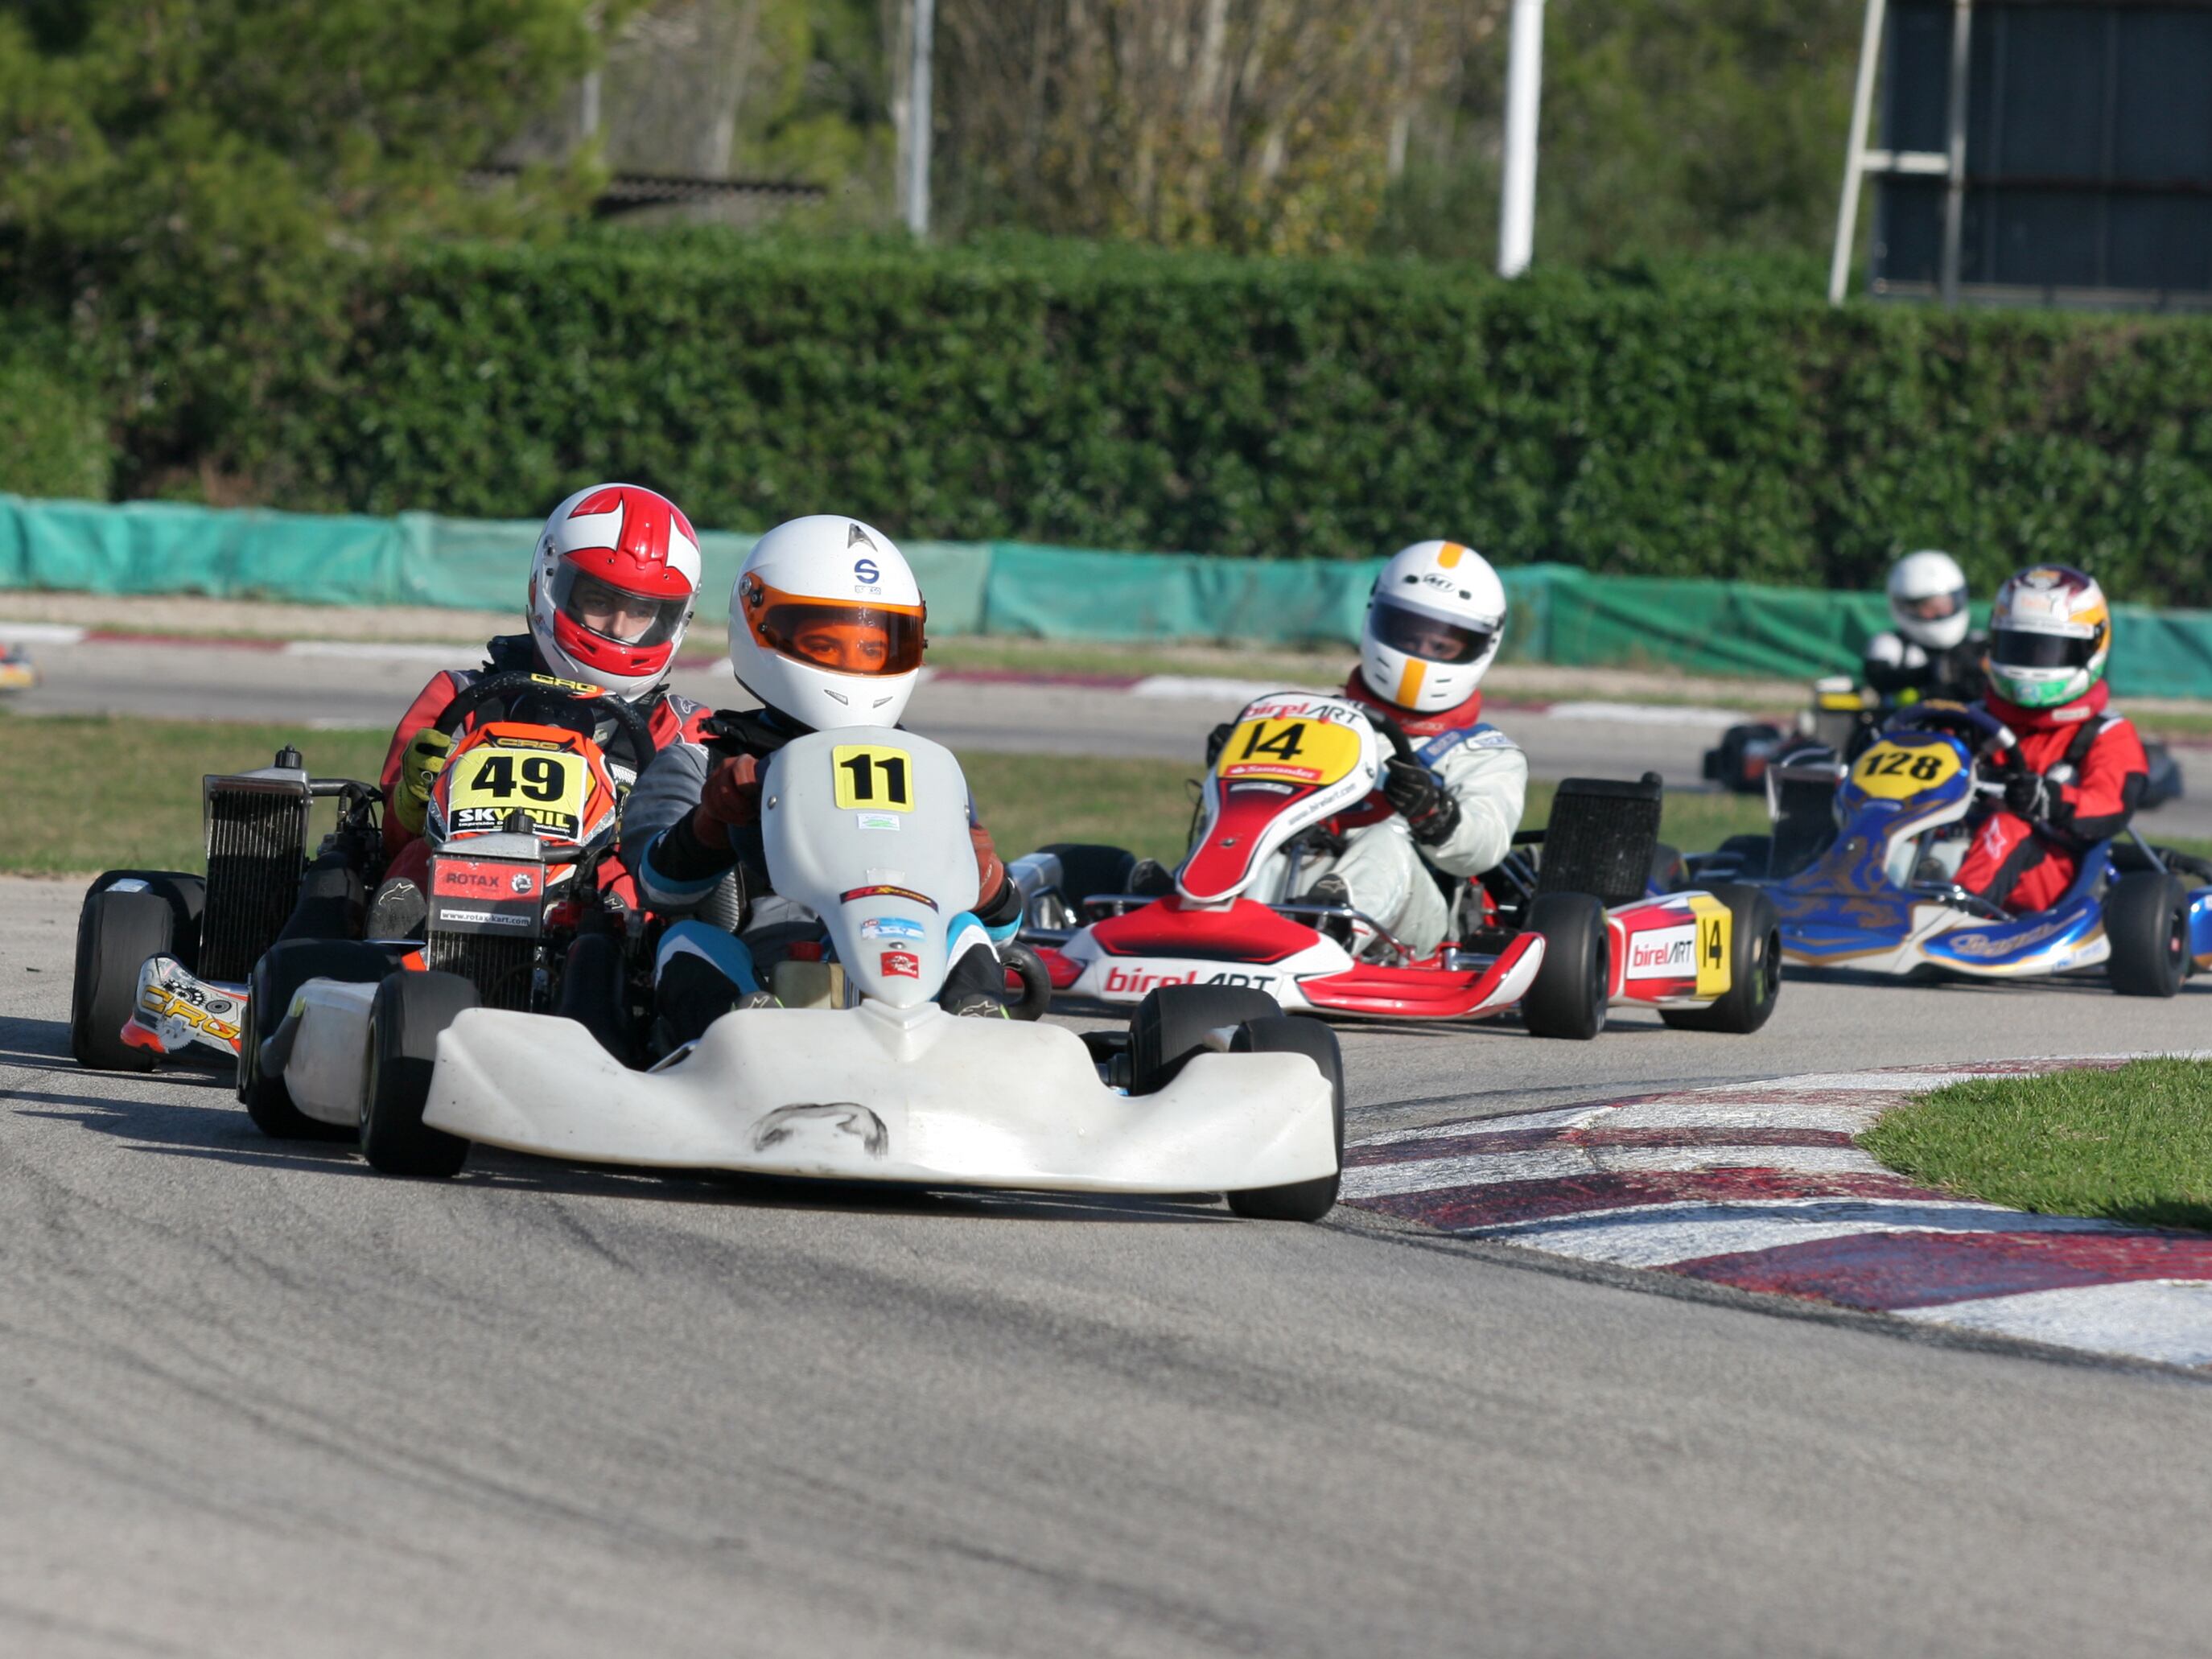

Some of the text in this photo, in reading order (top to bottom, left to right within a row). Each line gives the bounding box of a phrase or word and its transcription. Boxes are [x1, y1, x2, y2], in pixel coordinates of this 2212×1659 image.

[531, 673, 597, 693] CRG
[496, 738, 561, 751] CRG
[1240, 722, 1306, 760] 14
[471, 756, 566, 802] 49
[840, 754, 907, 805] 11
[1864, 751, 1943, 780] 128
[446, 871, 500, 888] ROTAX
[442, 912, 529, 926] www.rotax-kart.com
[1633, 940, 1693, 966] birelART
[1702, 919, 1723, 969] 14
[142, 985, 241, 1039] CRG
